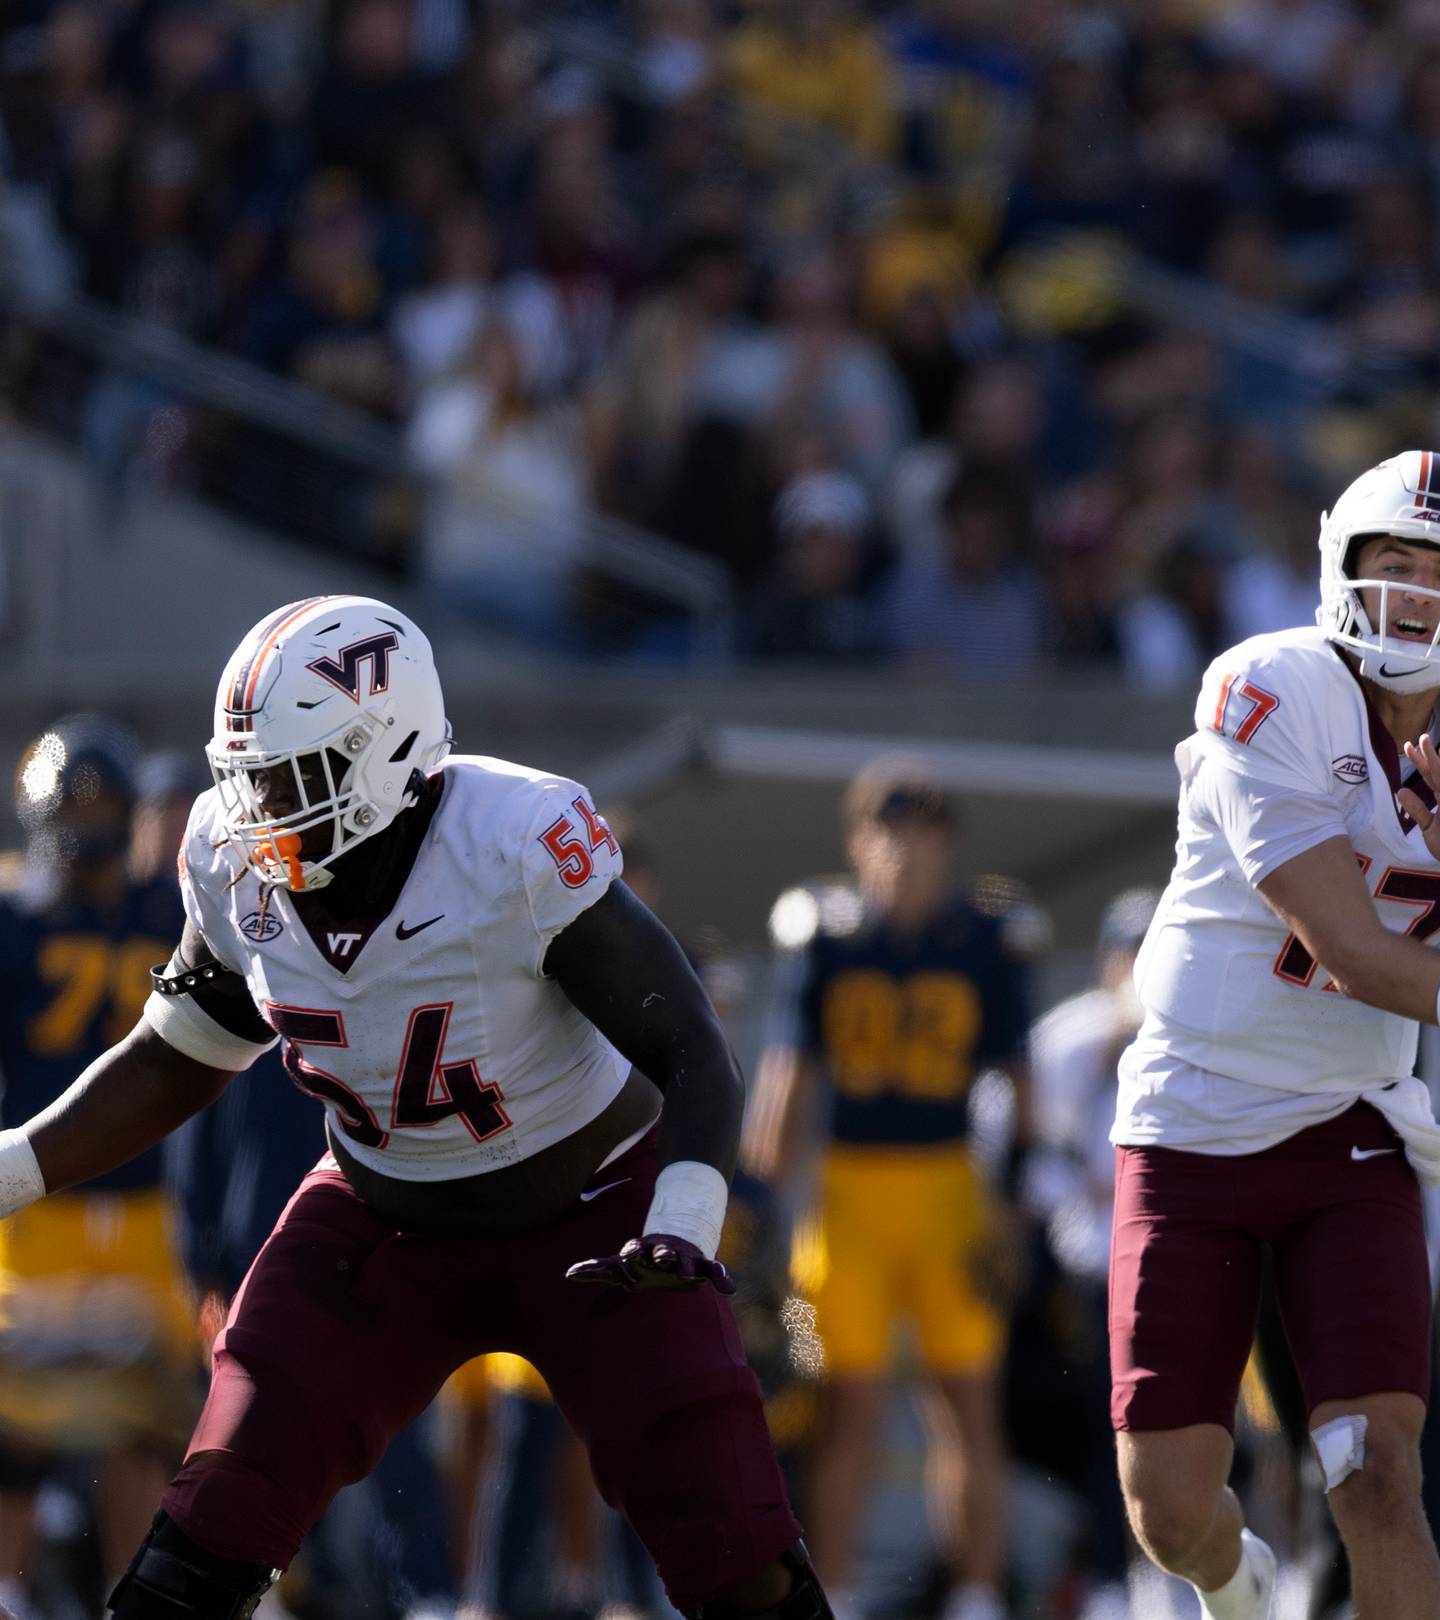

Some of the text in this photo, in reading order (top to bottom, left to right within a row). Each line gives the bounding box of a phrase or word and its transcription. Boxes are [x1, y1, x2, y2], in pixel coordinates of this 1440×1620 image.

[304, 631, 400, 705] VT
[1213, 673, 1281, 746] 17
[1338, 761, 1368, 775] ACC
[536, 795, 620, 890] 54
[326, 932, 363, 957] VT
[262, 998, 514, 1151] 54
